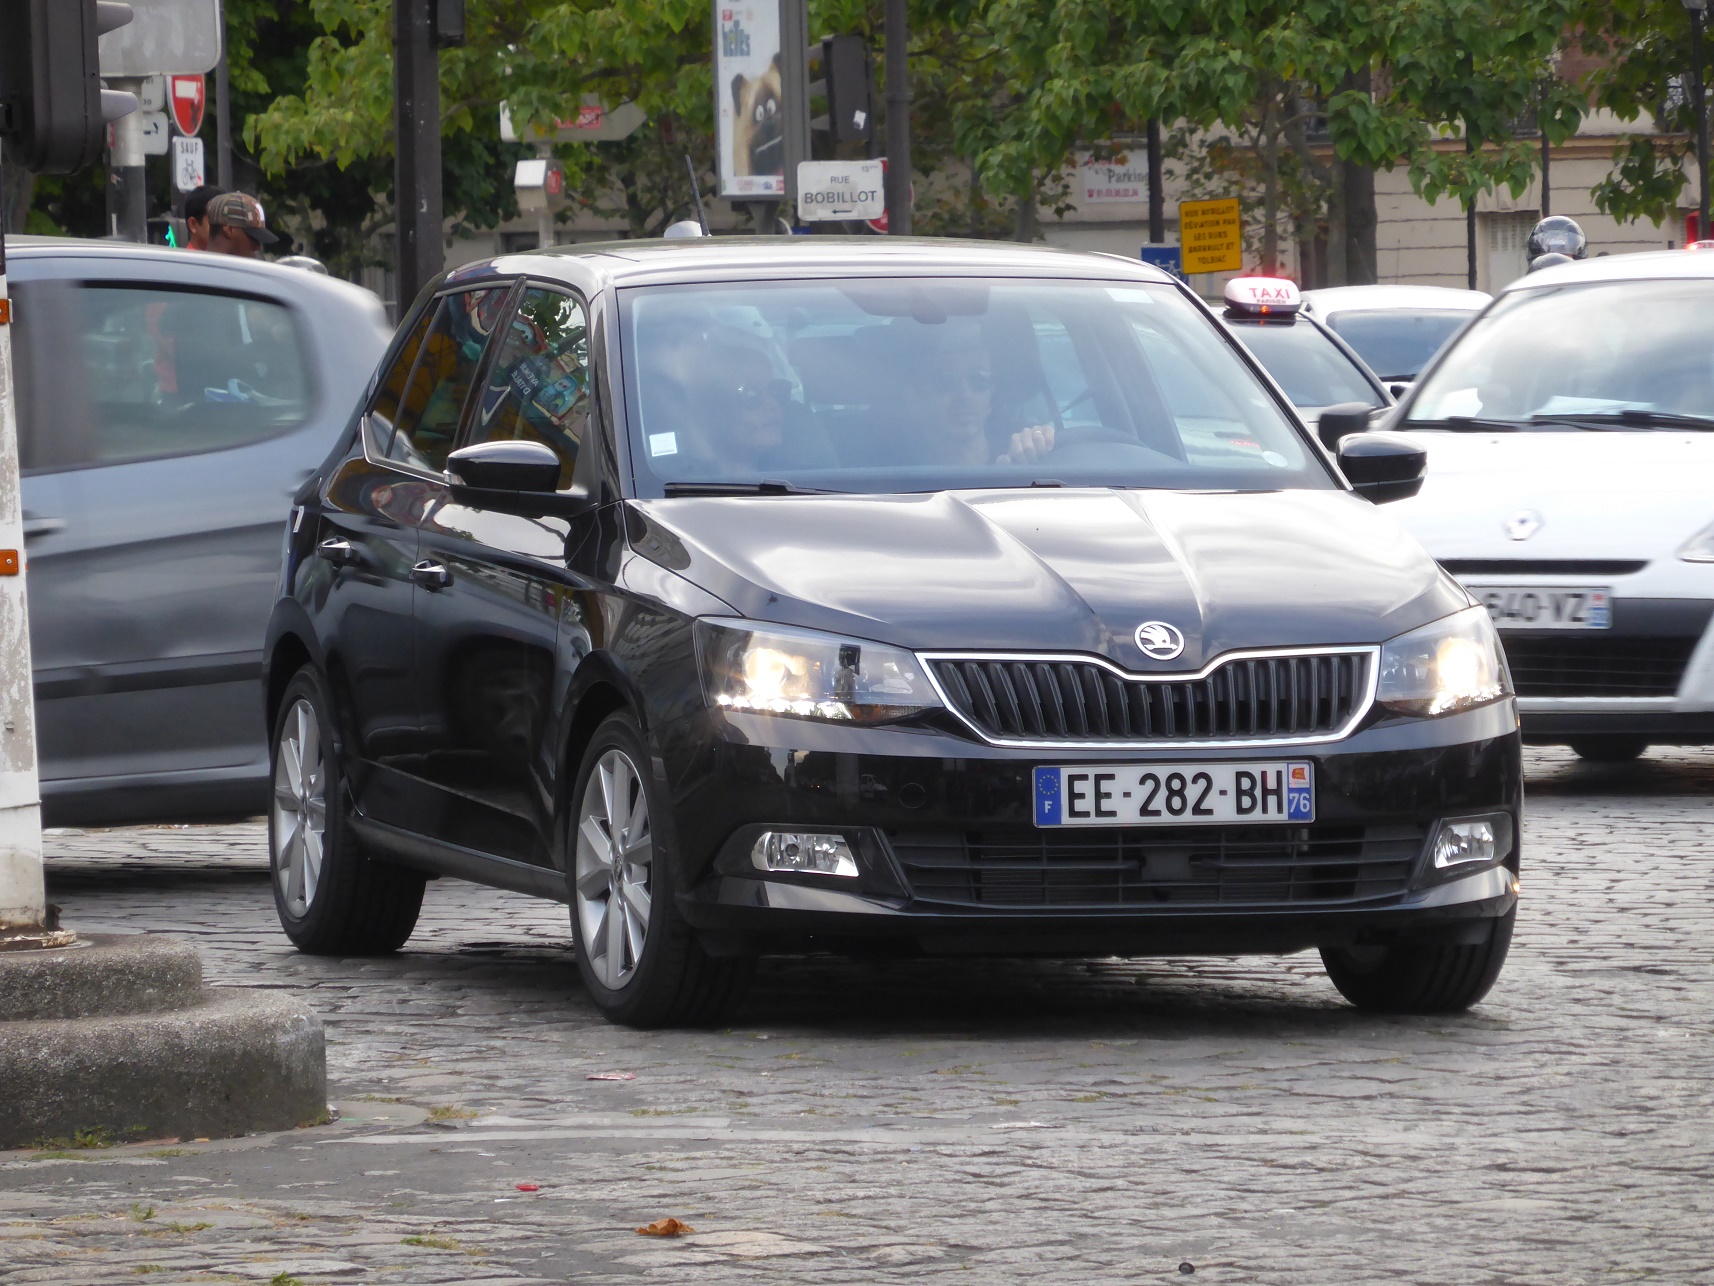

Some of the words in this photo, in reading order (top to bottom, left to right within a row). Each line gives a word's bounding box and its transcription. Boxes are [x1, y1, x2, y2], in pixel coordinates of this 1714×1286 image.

[181, 141, 198, 155] SAUF
[830, 176, 850, 184] RUE
[804, 191, 877, 204] BOBILLOT
[1185, 209, 1198, 217] RUE
[1193, 232, 1206, 241] LES
[1208, 231, 1228, 239] RUES
[1188, 243, 1224, 253] BARRAULT
[1226, 242, 1235, 250] ET
[1197, 255, 1226, 264] TOLBIAC
[1249, 288, 1290, 299] TAXI
[1067, 769, 1284, 818] EE-282-BH
[1044, 800, 1052, 813] F
[1289, 793, 1310, 813] 76
